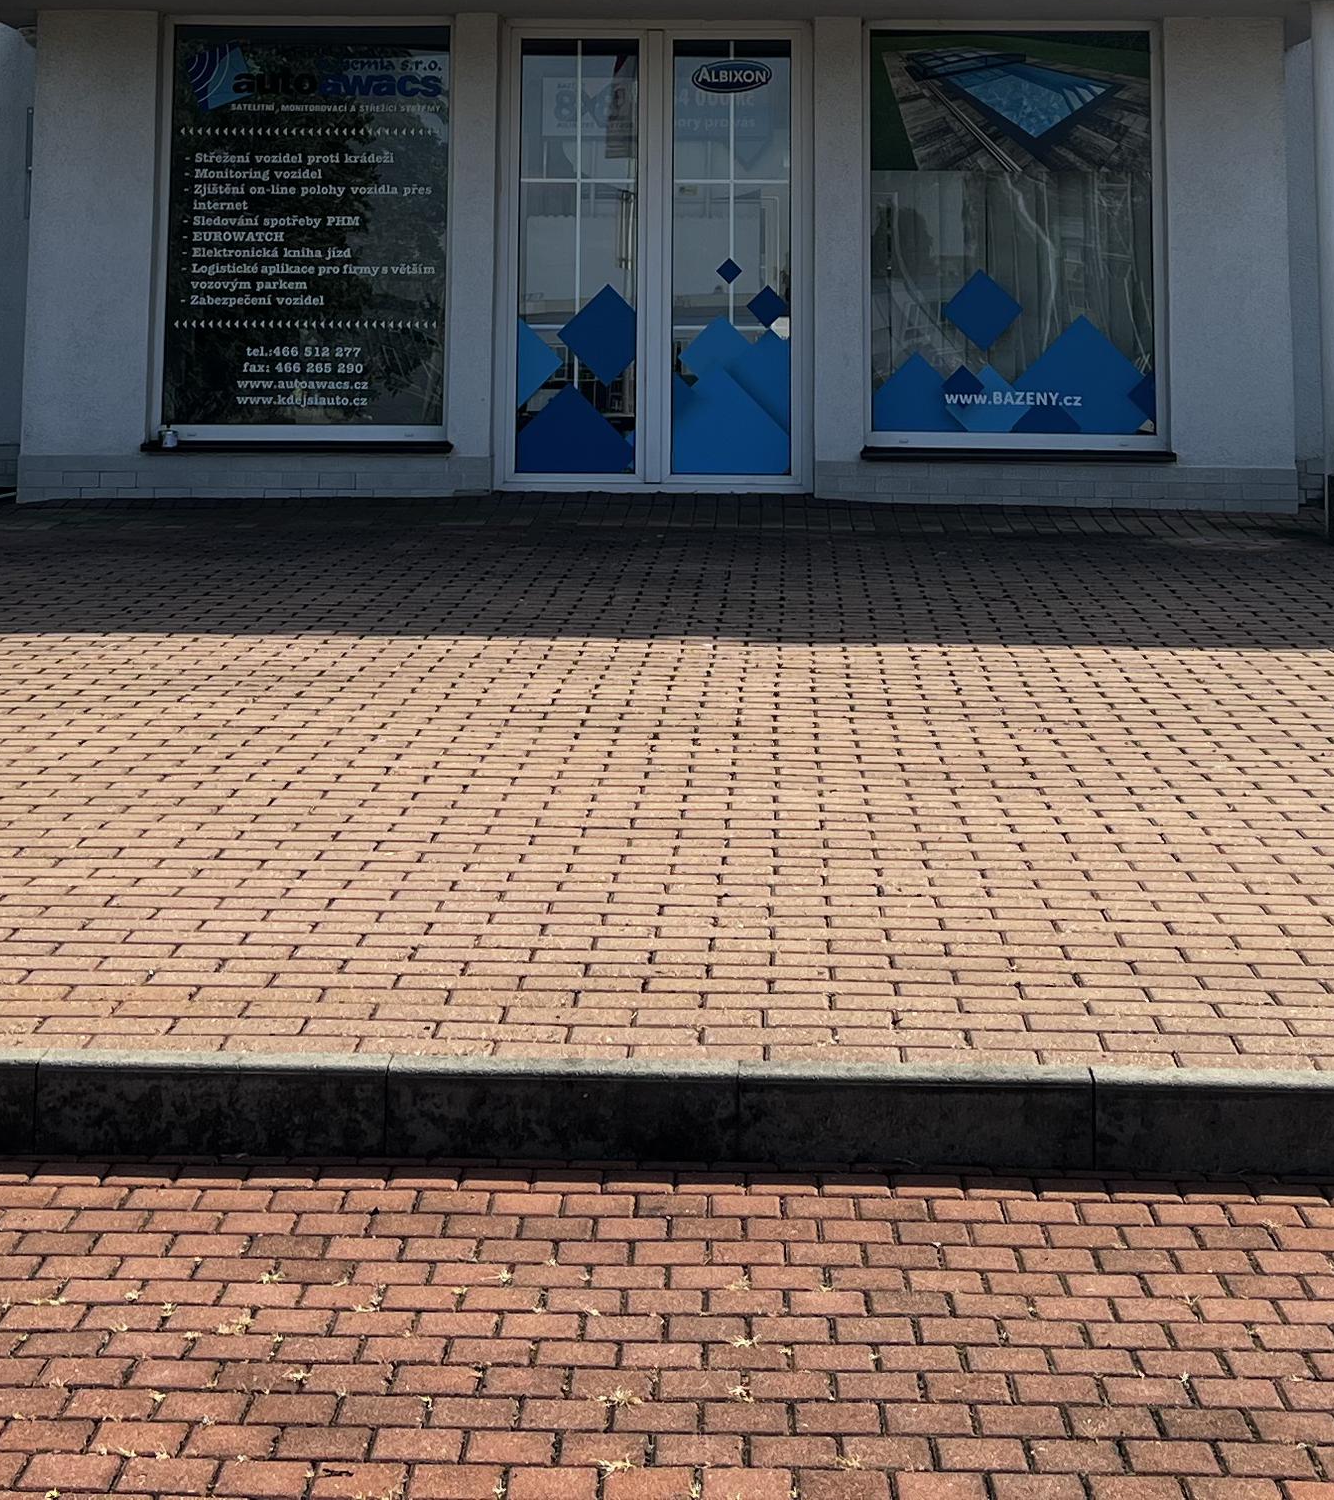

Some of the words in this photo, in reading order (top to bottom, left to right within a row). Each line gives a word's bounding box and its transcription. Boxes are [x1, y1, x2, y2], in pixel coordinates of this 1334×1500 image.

[698, 66, 766, 82] ALBIXON
[350, 104, 356, 113] A
[194, 151, 250, 164] Střežení
[255, 152, 303, 164] vozidel
[307, 152, 340, 166] proti
[344, 151, 395, 164] krádeži
[194, 168, 269, 181] Monitoring
[274, 168, 323, 179] vozidel
[193, 183, 245, 198] Zjištění
[249, 185, 296, 195] on-line
[301, 185, 346, 198] polohy
[350, 185, 398, 195] vozidla
[403, 184, 433, 198] přes
[193, 200, 249, 210] internet
[192, 215, 259, 226] Sledování
[263, 215, 322, 229] spotřeby
[326, 216, 360, 226] PHM
[192, 231, 285, 242] EUROWATCH
[191, 247, 279, 258] Elektronická
[283, 247, 322, 258] kniha
[325, 247, 352, 261] jízd
[191, 263, 259, 276] Logistické
[261, 264, 315, 277] aplikace
[318, 266, 340, 277] pro
[342, 264, 379, 277] firmy
[391, 263, 436, 275] větším
[190, 279, 252, 293] vozovým
[256, 279, 308, 293] parkem
[190, 294, 272, 308] Zabezpečení
[276, 295, 324, 306] vozidel
[304, 346, 330, 357] 512
[334, 347, 361, 357] 277
[242, 362, 270, 373] fax:
[275, 362, 301, 373] 466
[306, 362, 332, 373] 265
[337, 363, 364, 374] 290
[236, 378, 369, 390] www.autoawacs.cz
[236, 394, 368, 408] www.kdejsiauto.cz
[944, 391, 1083, 407] www.BAZENY.cz
